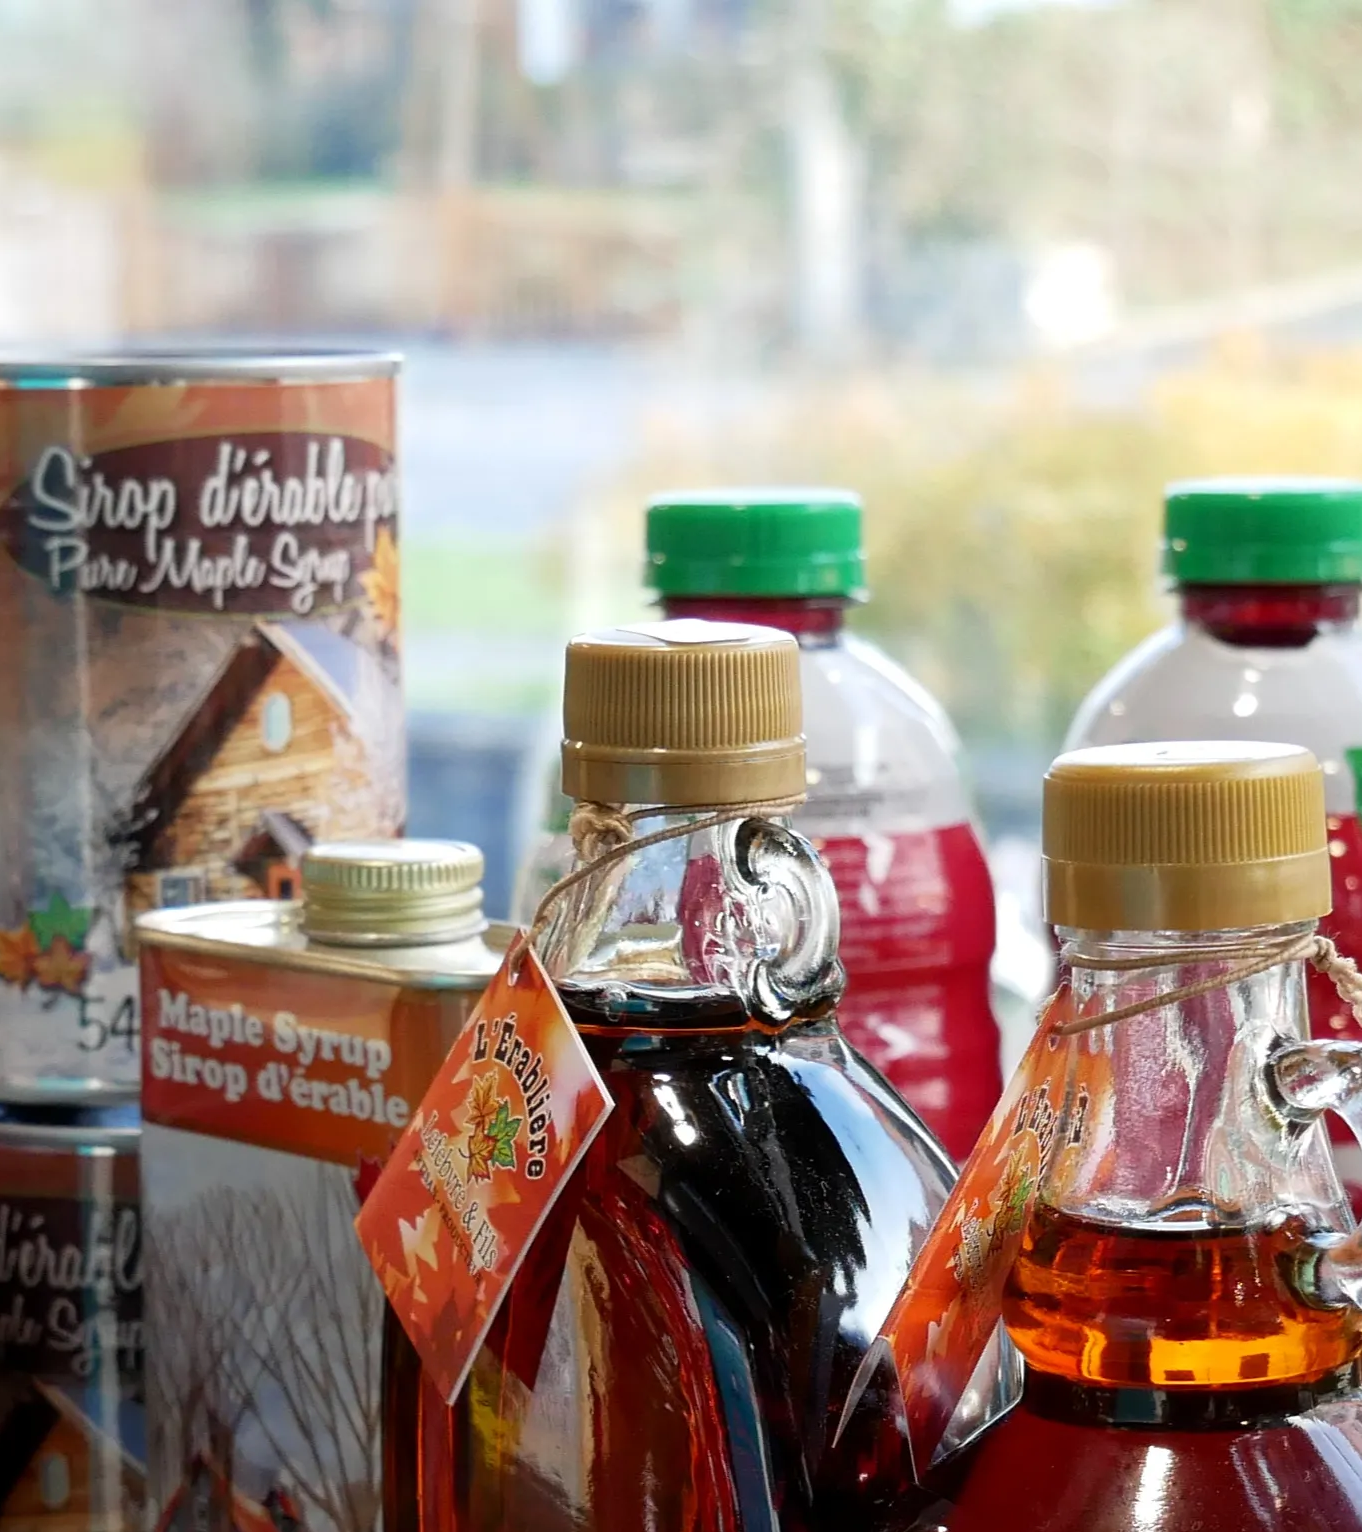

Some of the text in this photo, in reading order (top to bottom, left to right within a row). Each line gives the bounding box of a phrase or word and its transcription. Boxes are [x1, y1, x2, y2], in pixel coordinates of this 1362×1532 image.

[26, 444, 176, 564] Sirop
[199, 437, 358, 528] d'érable
[44, 534, 352, 616] Pure Maple Syrup
[149, 1036, 410, 1130] Sirop d'érable
[155, 988, 393, 1080] Maple Syrup
[471, 1012, 555, 1181] L'Érablière
[421, 1110, 468, 1211] Lefebvre
[461, 1201, 480, 1232] &
[472, 1219, 499, 1272] Fils
